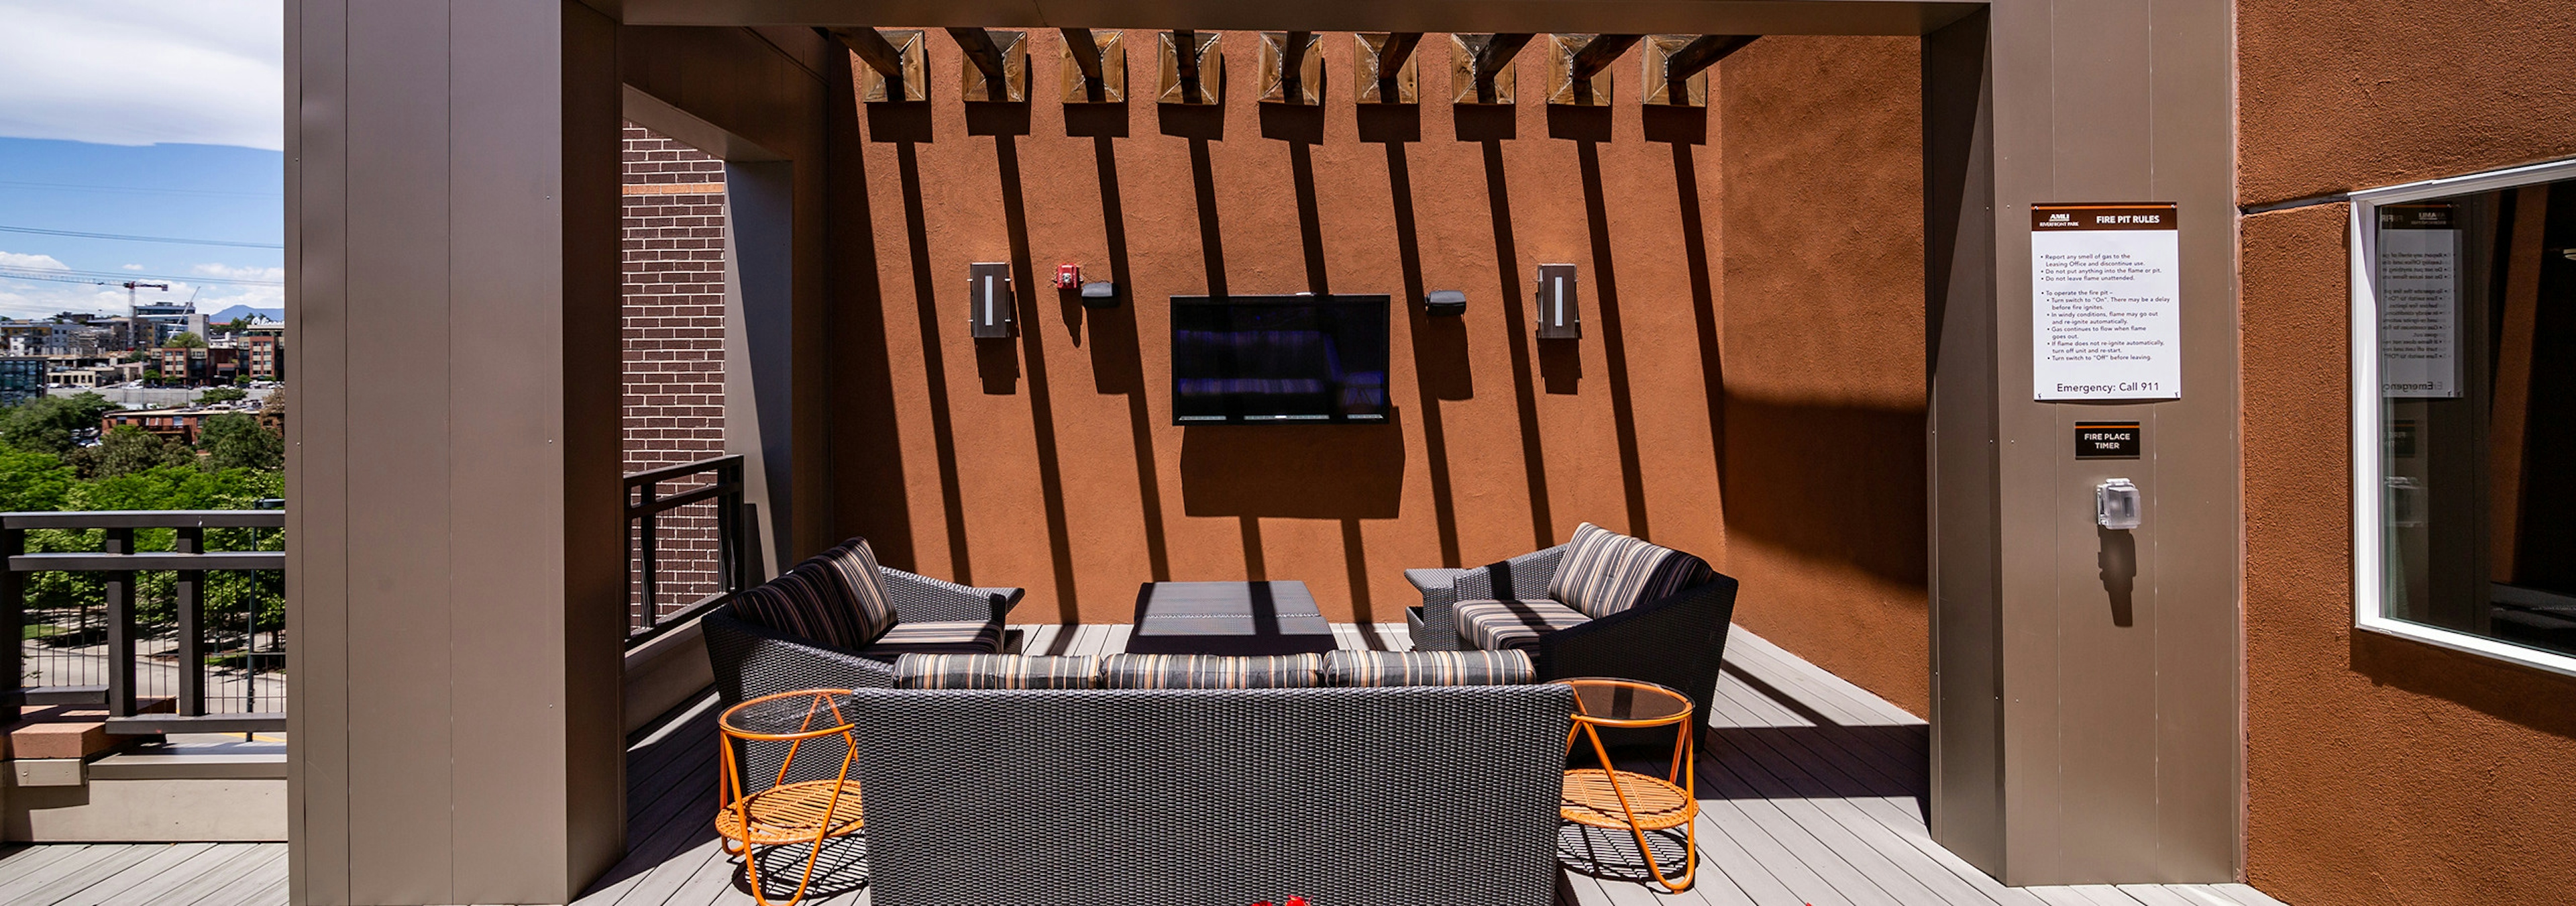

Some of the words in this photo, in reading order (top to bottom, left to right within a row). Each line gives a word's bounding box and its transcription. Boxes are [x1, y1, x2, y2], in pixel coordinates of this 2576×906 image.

[2057, 383, 2116, 394] Emergency:
[2119, 382, 2138, 391] Call
[2142, 382, 2160, 390] 911
